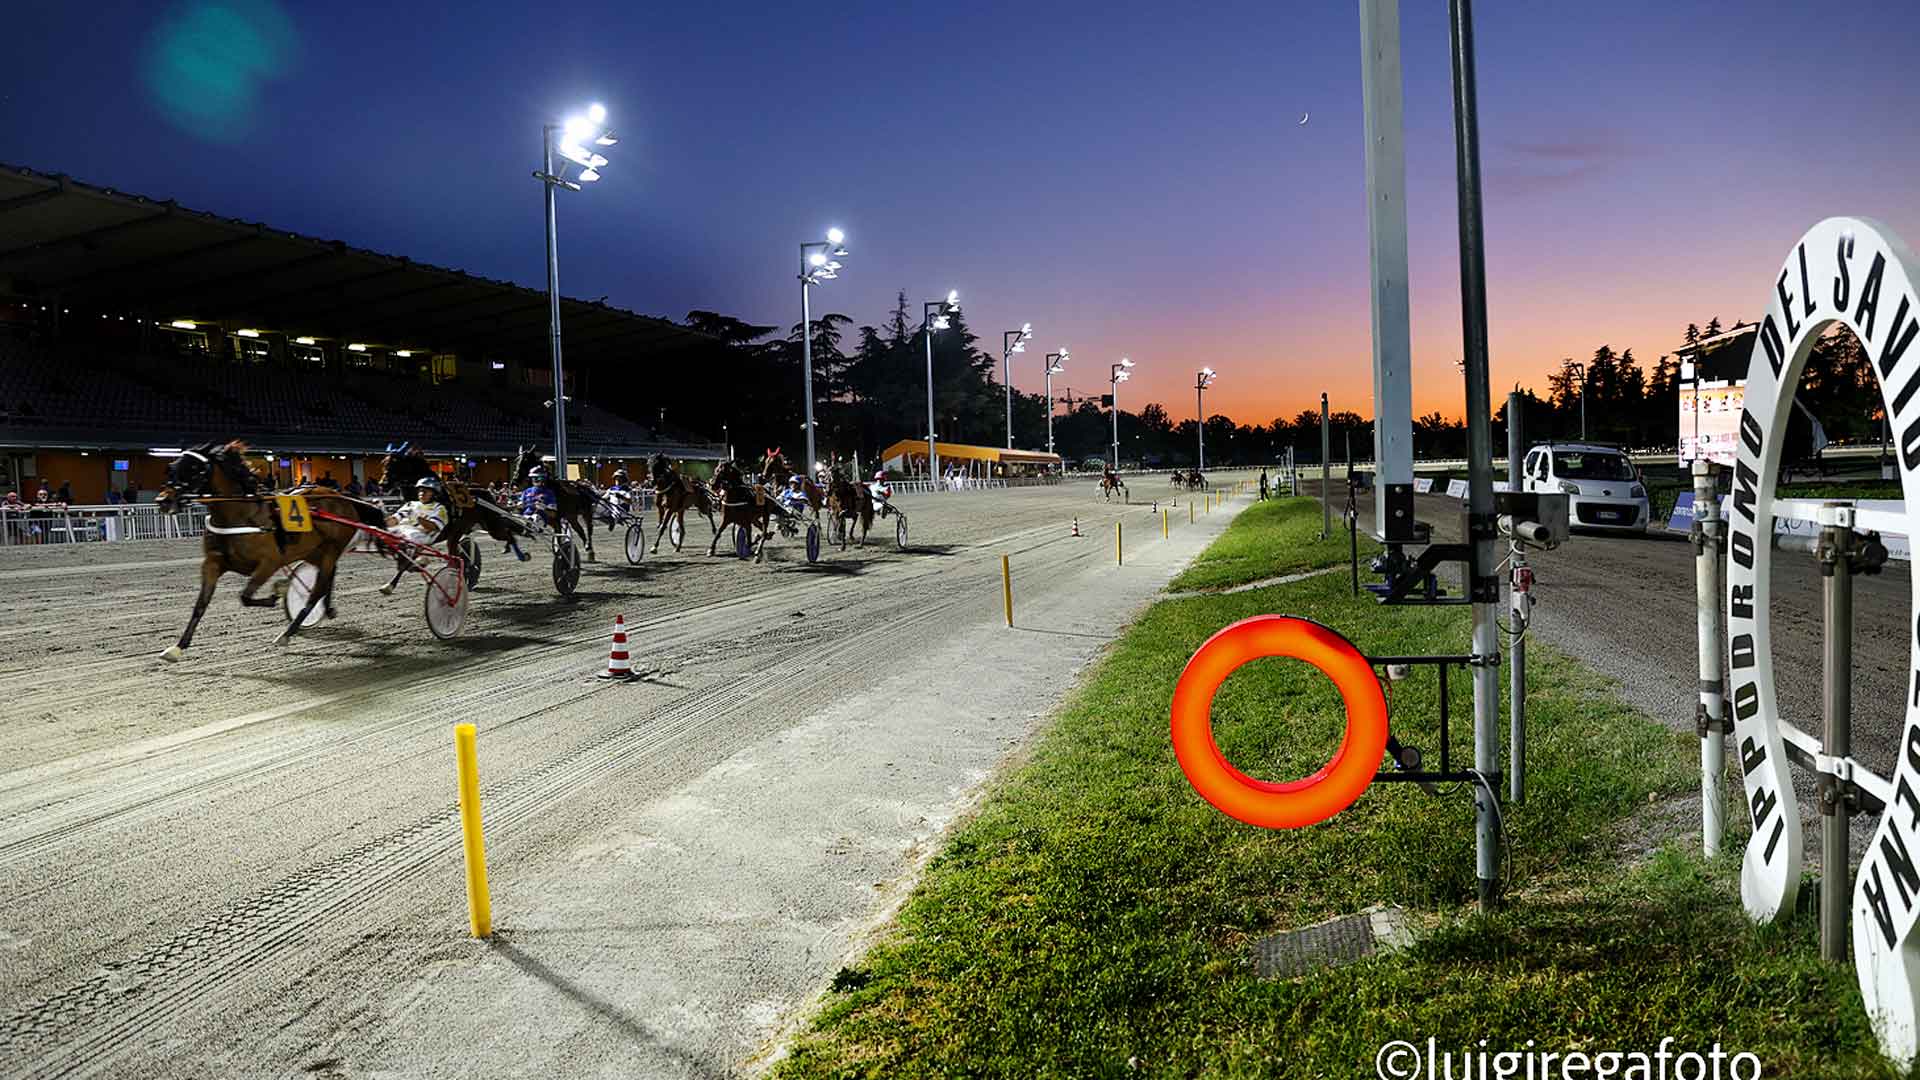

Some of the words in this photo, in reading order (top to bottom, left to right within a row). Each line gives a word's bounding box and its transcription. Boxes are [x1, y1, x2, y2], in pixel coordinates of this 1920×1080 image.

[288, 499, 304, 528] 4
[1731, 407, 1783, 865] IPPODROMO
[1760, 242, 1817, 381] DEL
